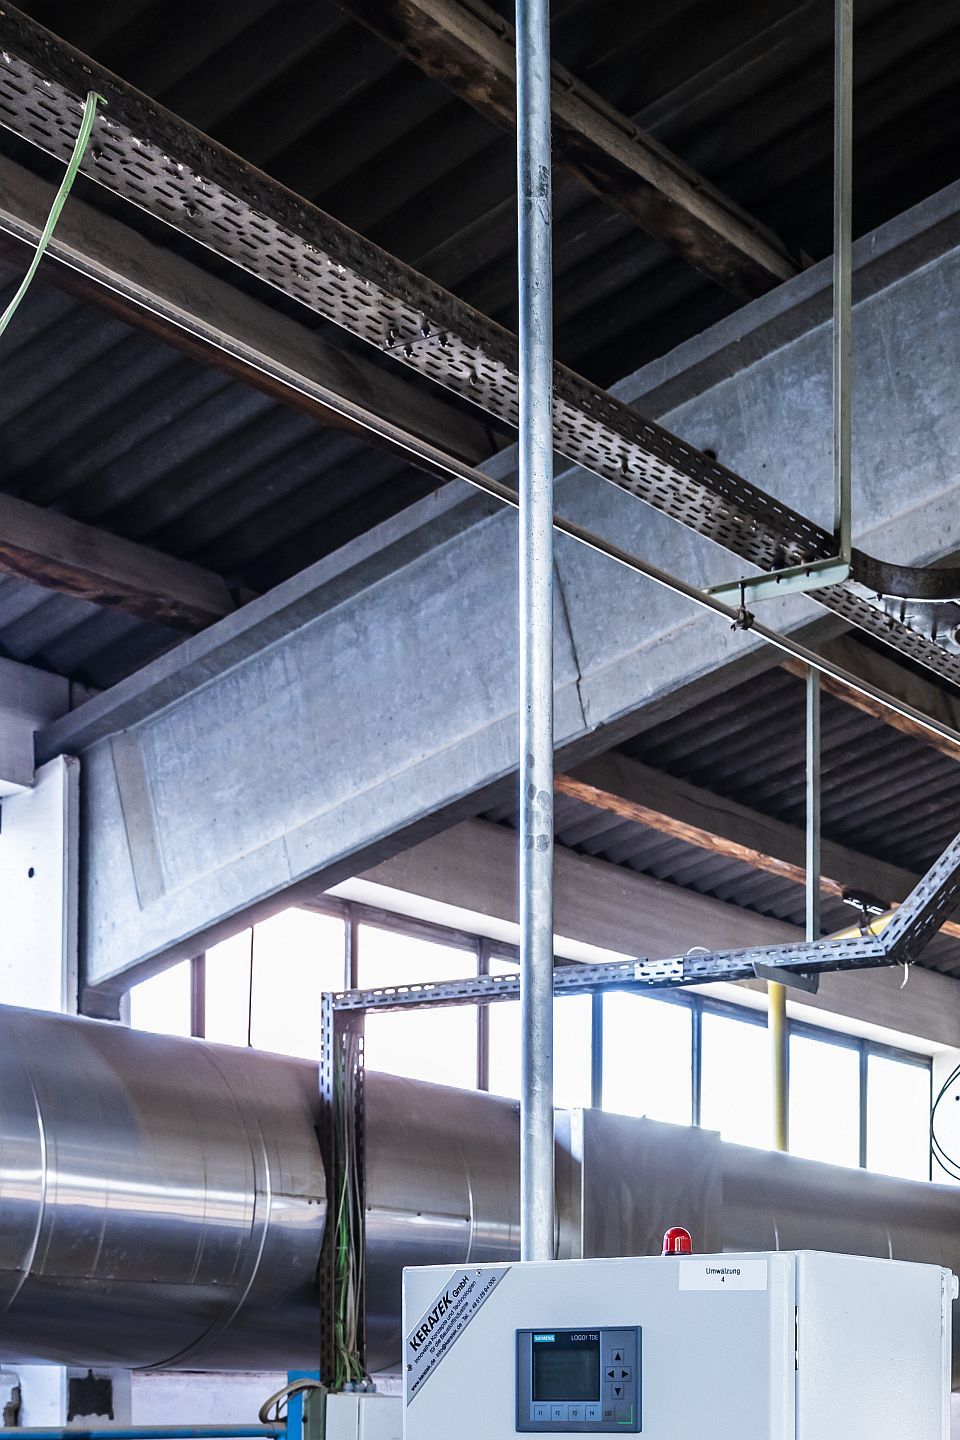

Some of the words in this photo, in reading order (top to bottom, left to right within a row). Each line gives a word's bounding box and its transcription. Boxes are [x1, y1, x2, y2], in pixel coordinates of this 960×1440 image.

[705, 1267, 741, 1276] Umwälzung
[409, 1290, 454, 1352] KERATEK
[452, 1275, 470, 1298] GmbH
[413, 1339, 433, 1364] Innovative
[430, 1319, 448, 1342] Konzepte
[446, 1309, 455, 1321] und
[452, 1280, 477, 1311] Technologien
